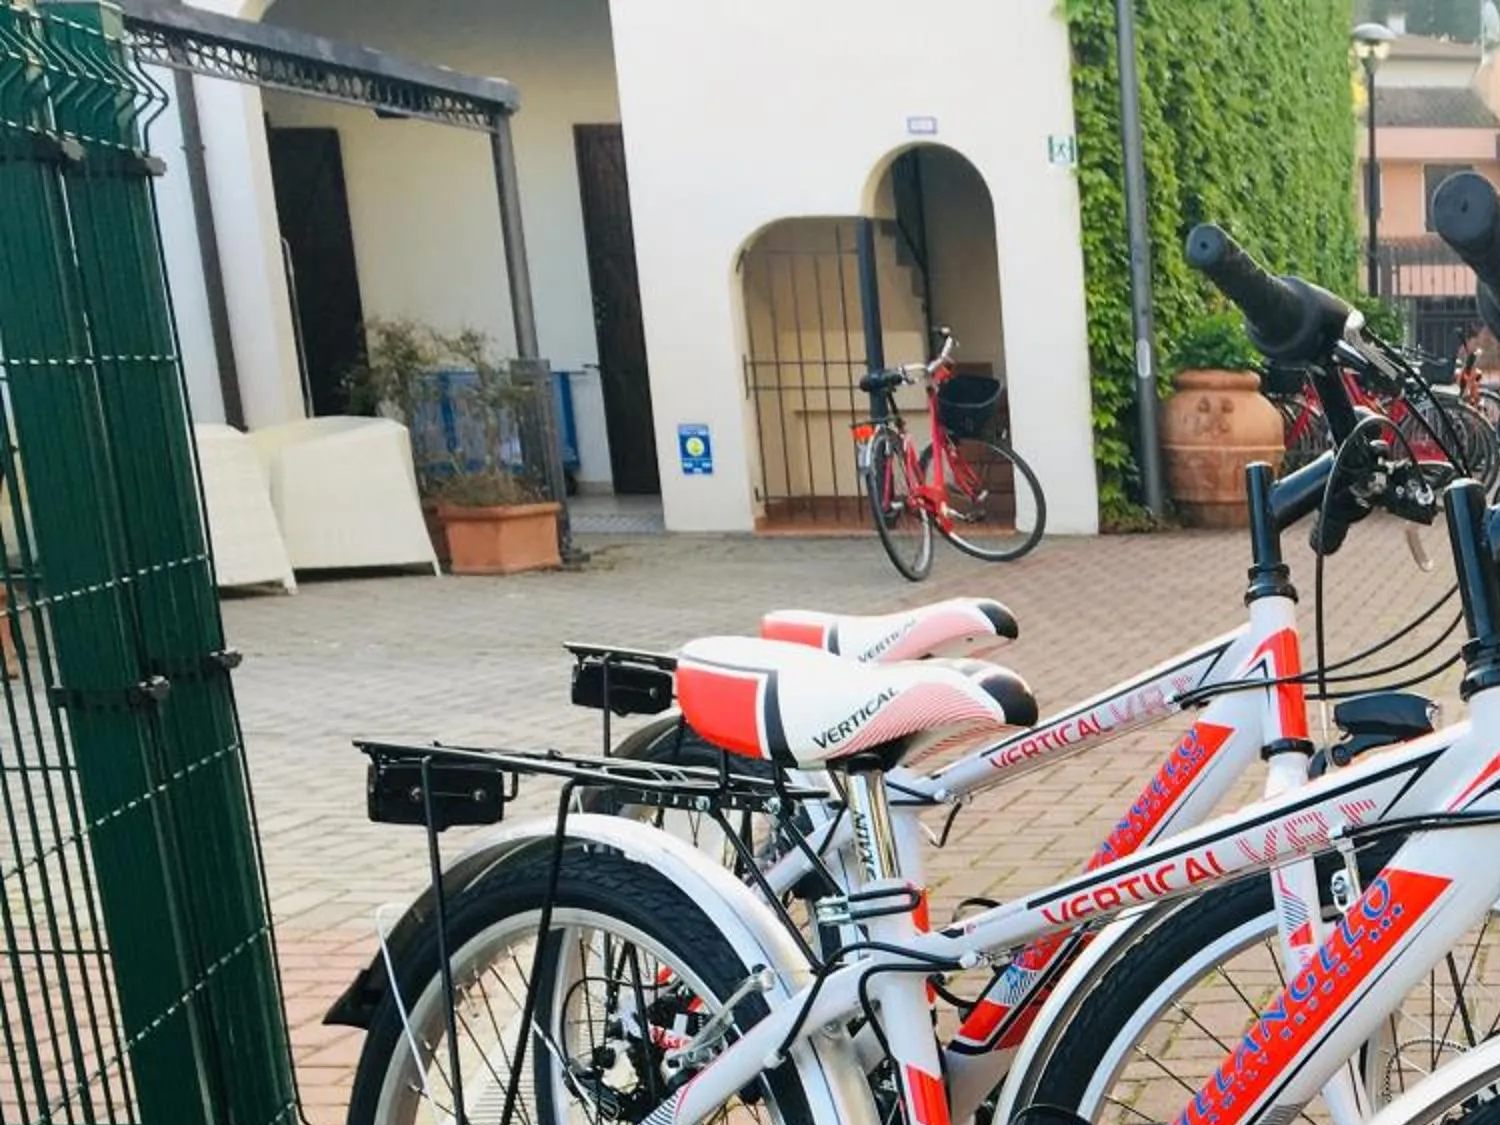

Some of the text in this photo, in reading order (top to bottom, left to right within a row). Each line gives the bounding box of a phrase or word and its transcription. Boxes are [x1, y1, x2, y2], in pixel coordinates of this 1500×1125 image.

[813, 687, 900, 750] VERTICAL
[988, 712, 1114, 768] VERTICAL
[1041, 851, 1228, 926] VERTICAL
